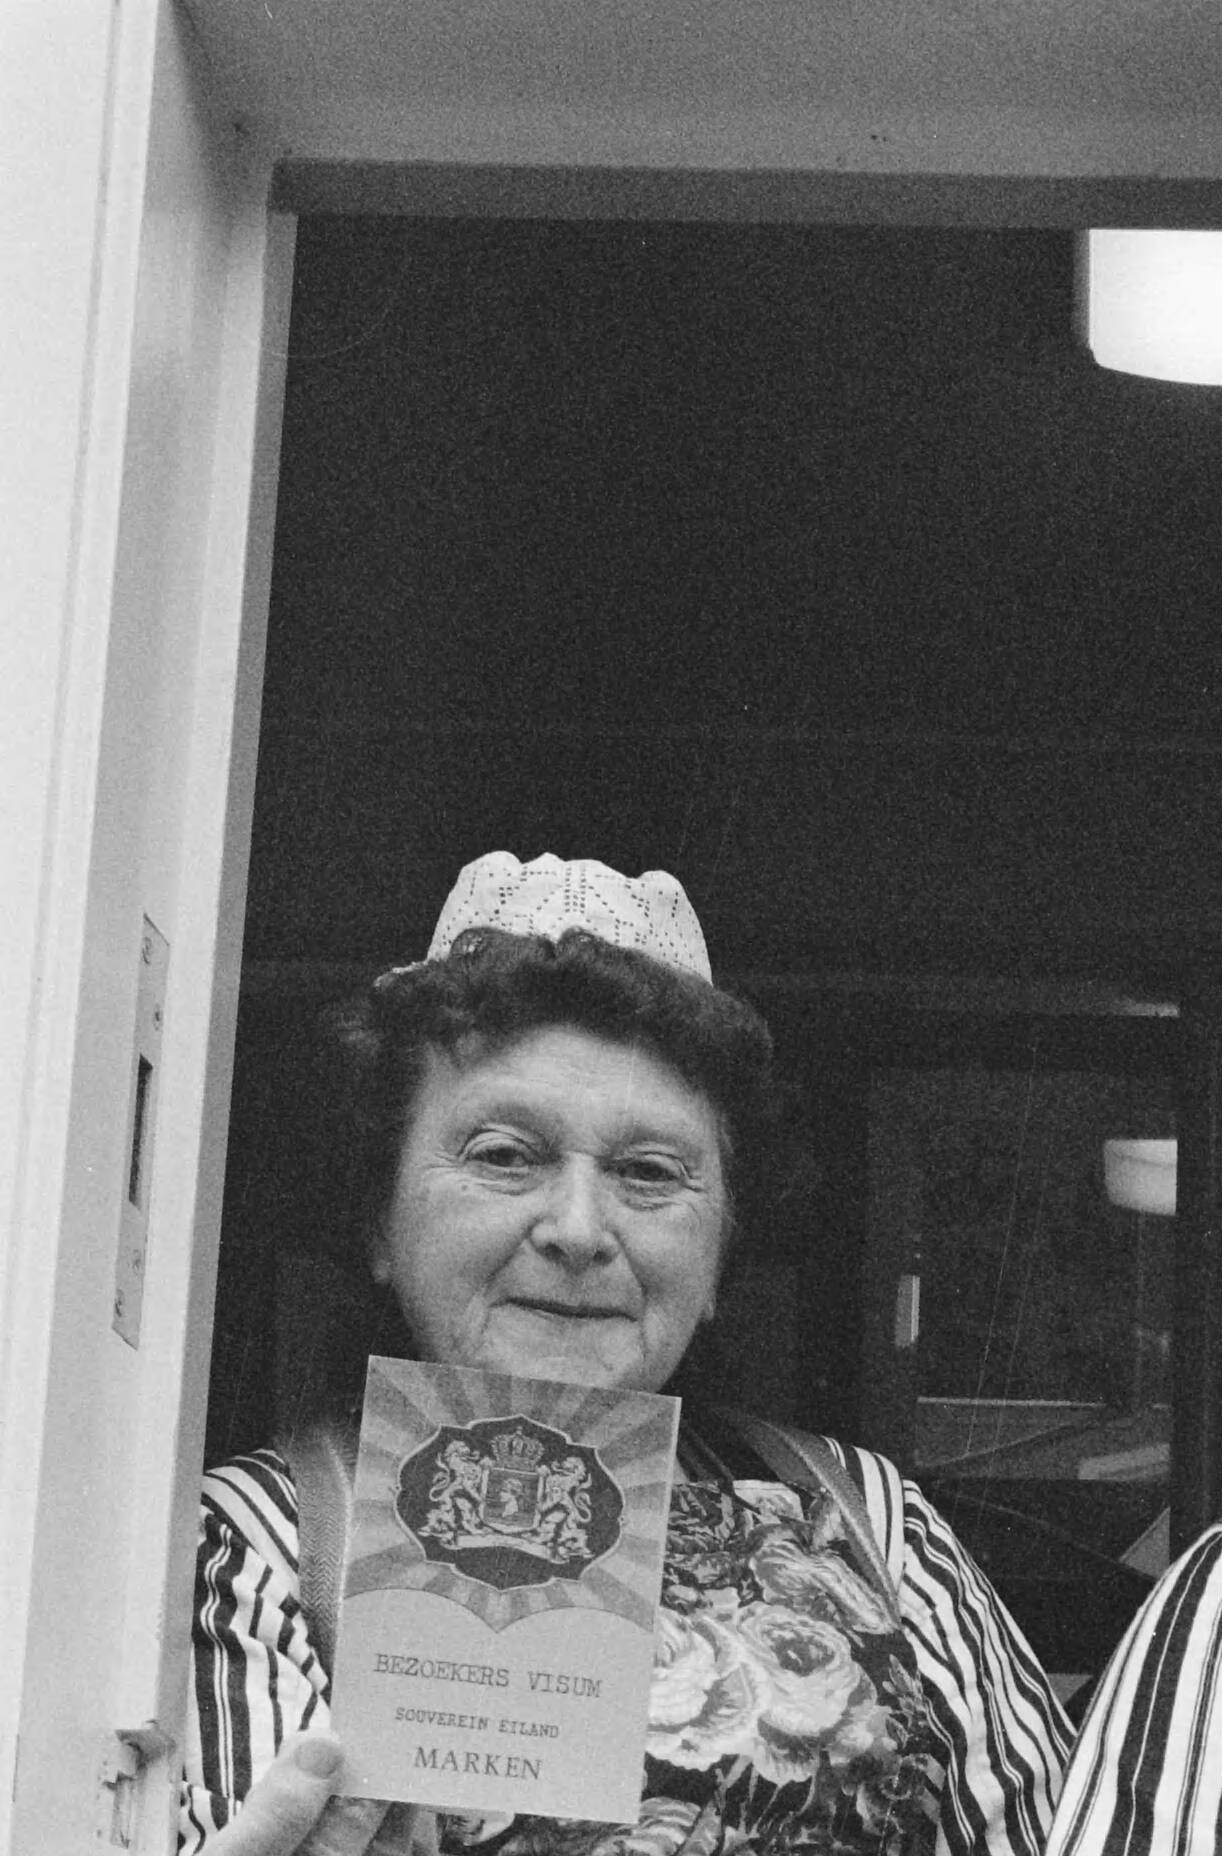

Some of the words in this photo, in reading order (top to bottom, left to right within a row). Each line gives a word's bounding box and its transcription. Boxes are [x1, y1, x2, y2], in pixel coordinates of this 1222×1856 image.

[373, 1653, 509, 1687] BEZOEKERS
[528, 1672, 601, 1698] VISUM
[395, 1707, 488, 1730] SOUVEREIN
[499, 1720, 558, 1738] EILAND
[415, 1747, 541, 1779] MARKEN
